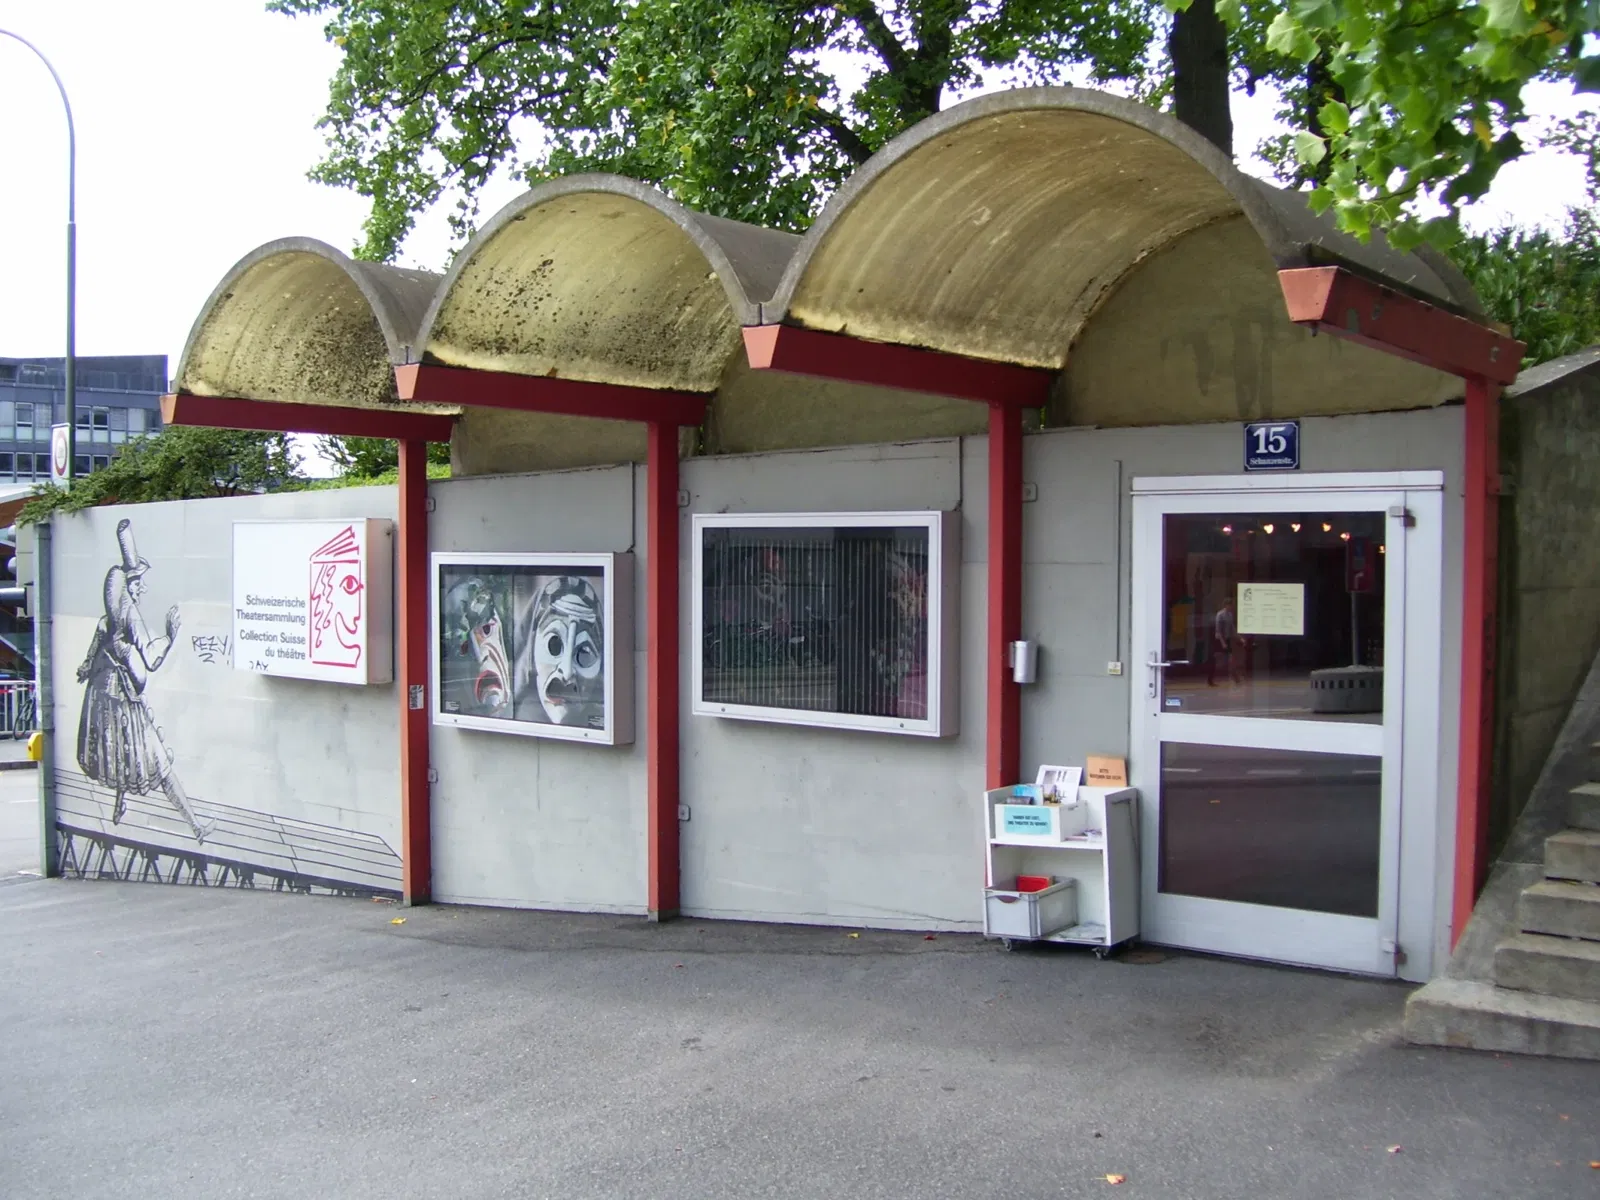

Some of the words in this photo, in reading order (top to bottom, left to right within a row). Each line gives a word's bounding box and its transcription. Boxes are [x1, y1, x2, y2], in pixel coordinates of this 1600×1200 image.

[1253, 427, 1287, 454] 15
[246, 595, 306, 608] Schweizerische
[236, 609, 306, 626] Theatersammlung
[239, 629, 278, 643] Collection
[280, 632, 306, 645] Suisse
[264, 647, 275, 657] du
[277, 648, 306, 660] théâtre
